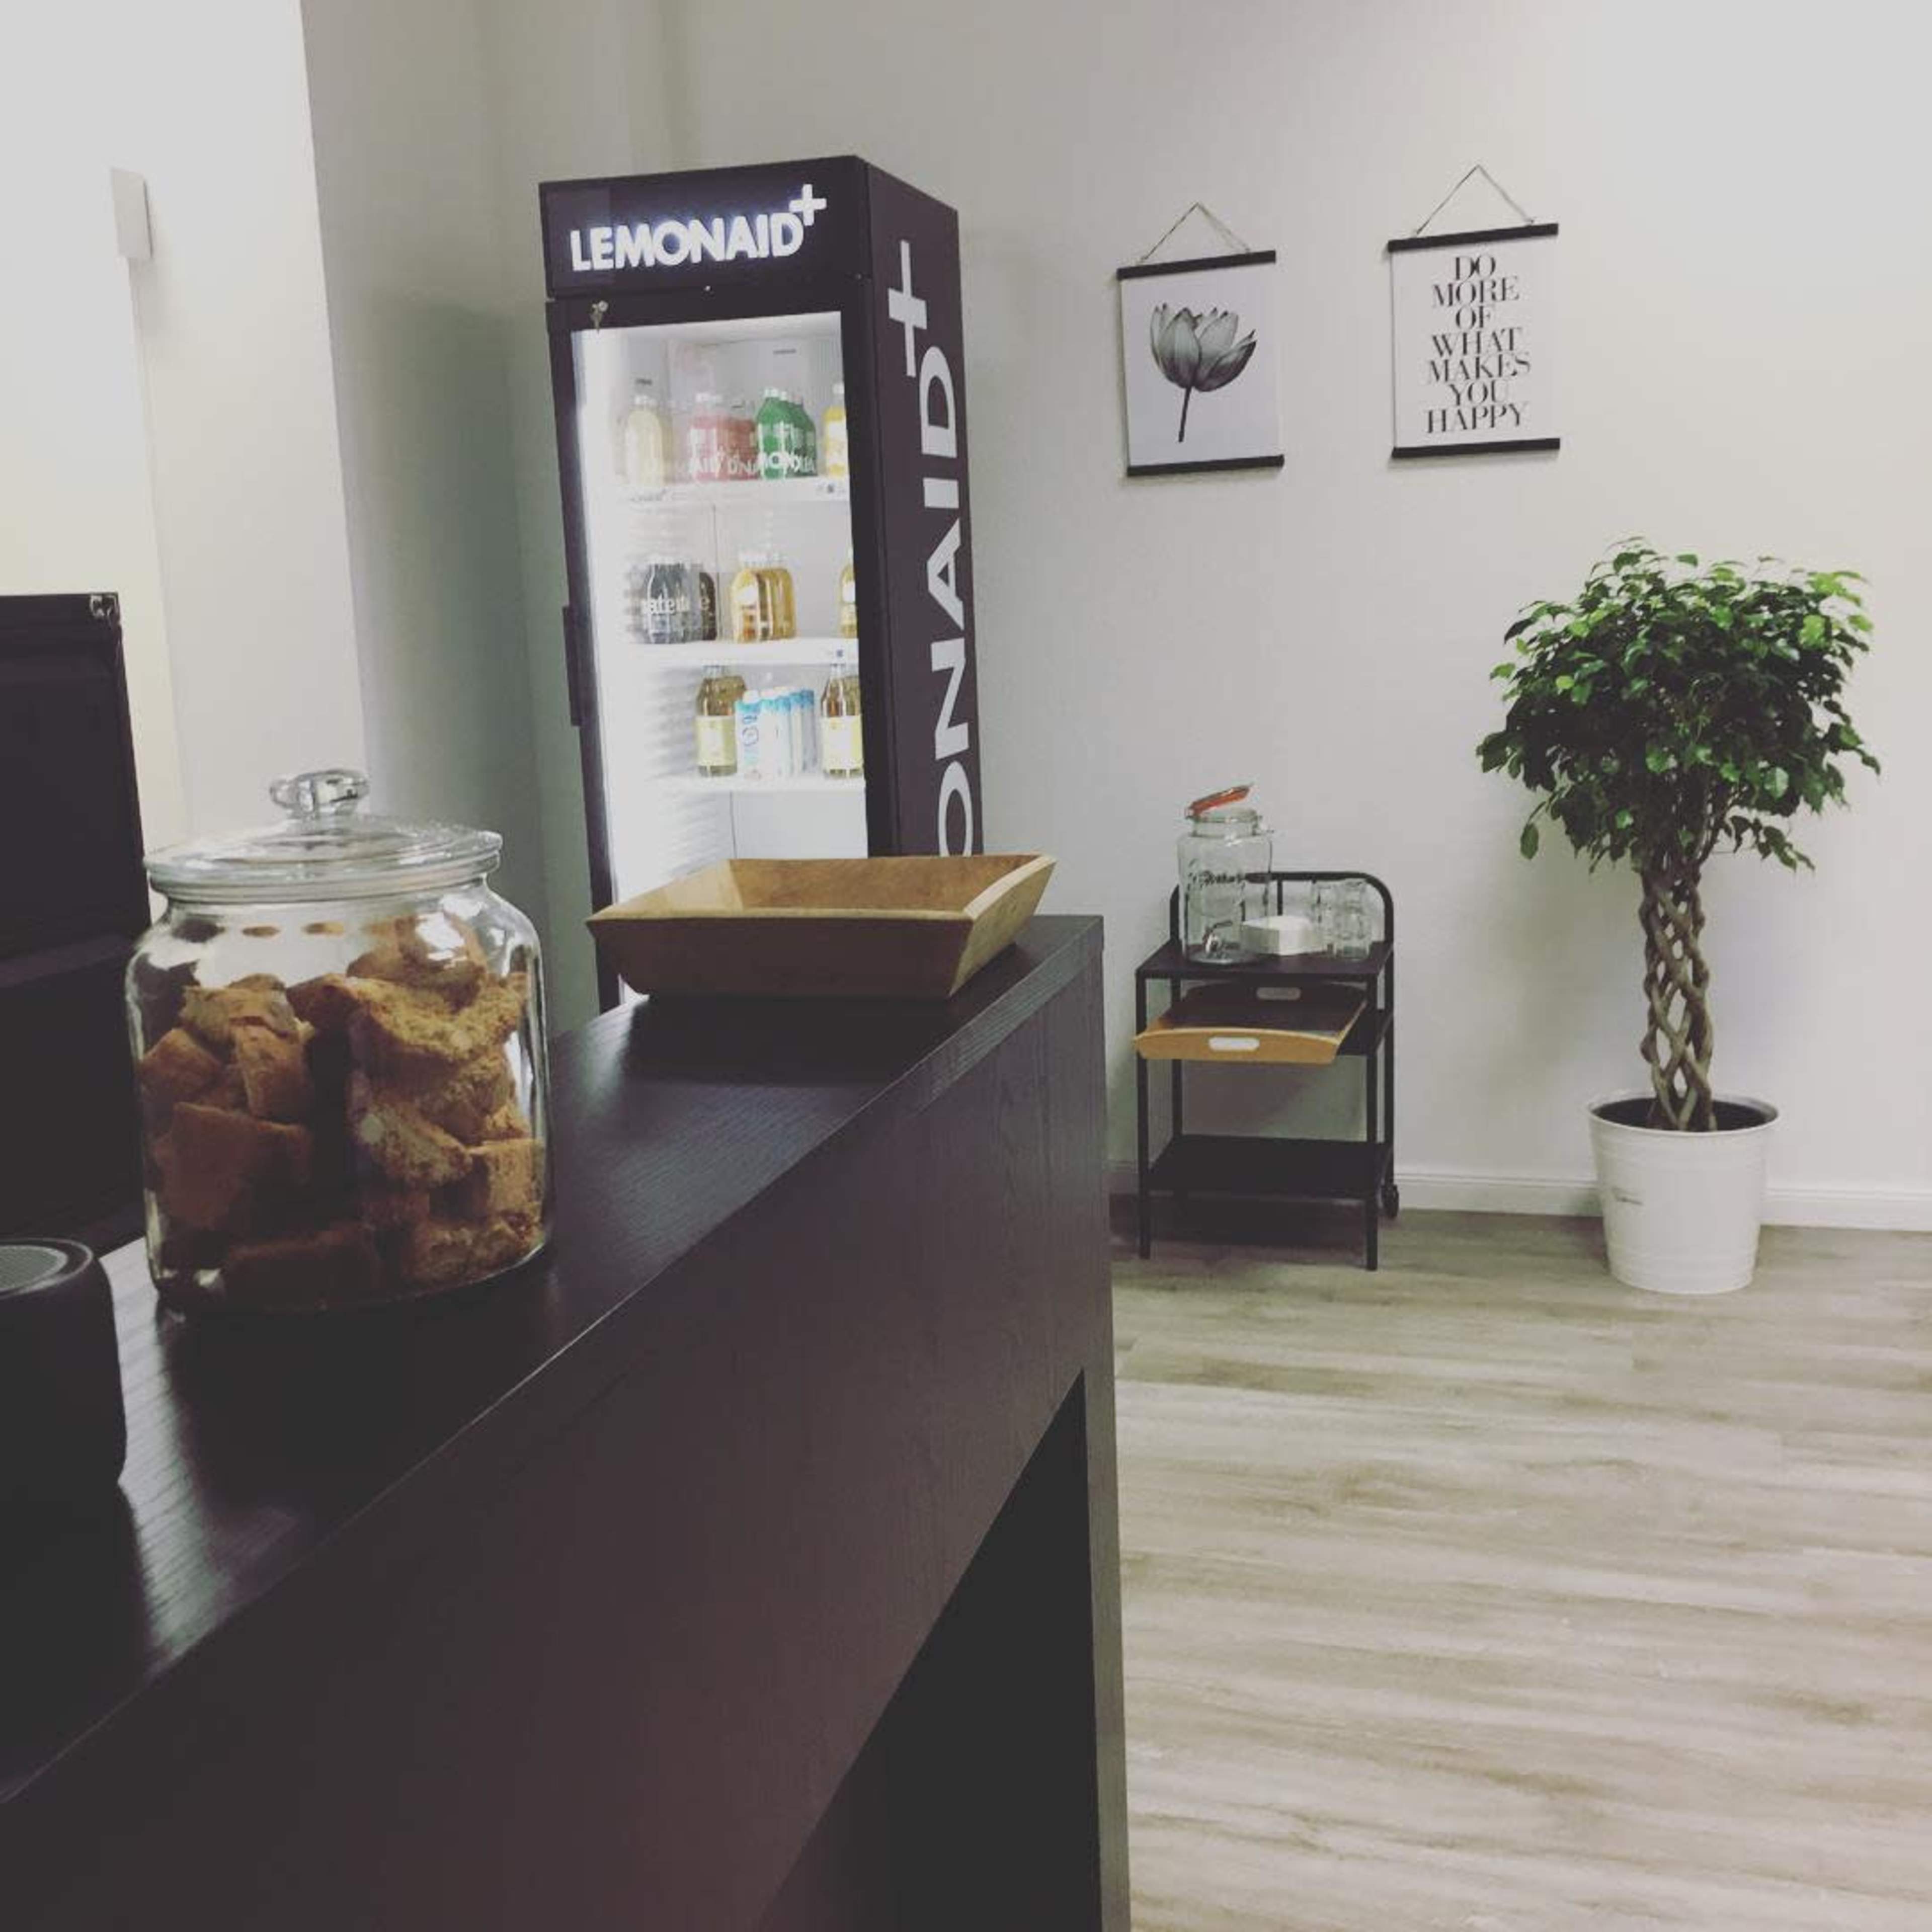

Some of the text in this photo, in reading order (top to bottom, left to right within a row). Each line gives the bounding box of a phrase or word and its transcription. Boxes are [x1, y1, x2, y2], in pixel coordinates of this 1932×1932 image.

[1455, 254, 1496, 280] DO
[1433, 276, 1520, 307] MORE
[1456, 304, 1493, 330] OF
[1432, 328, 1523, 357] WHAT
[1427, 353, 1531, 383] MAKES
[1448, 379, 1509, 406] YOU
[1427, 402, 1526, 433] HAPPY
